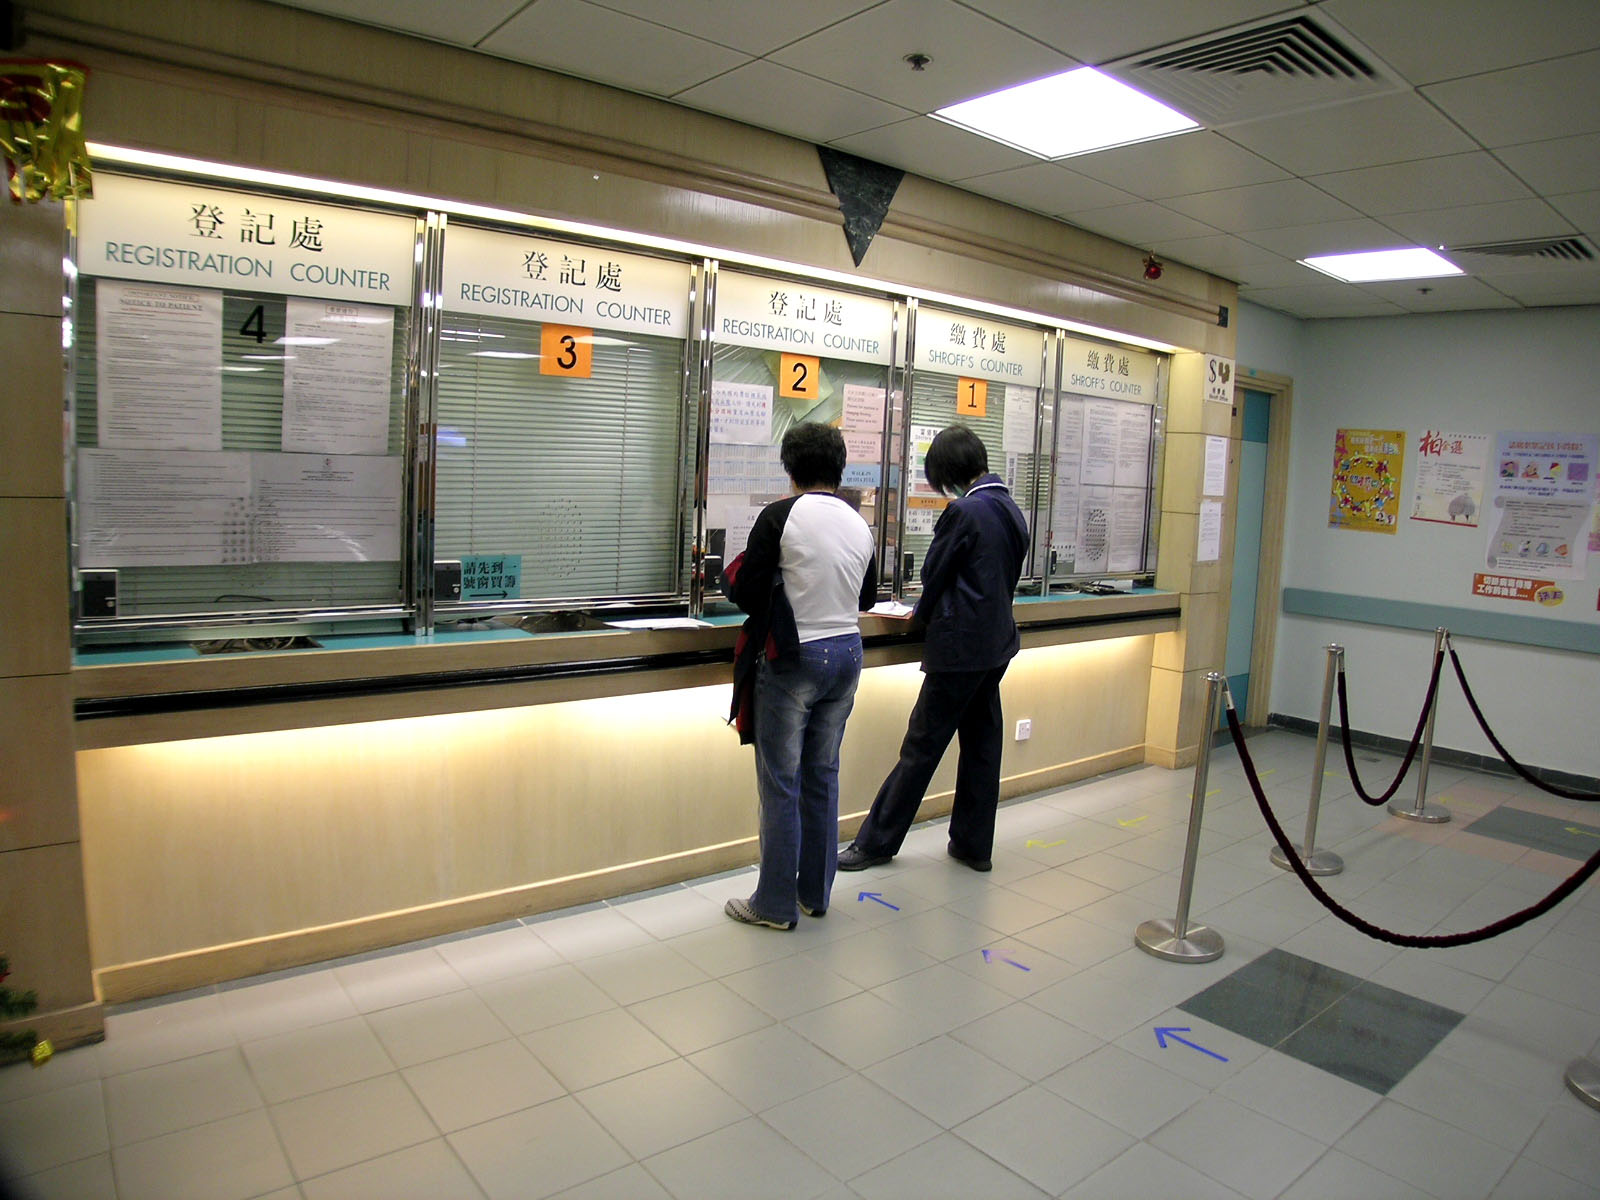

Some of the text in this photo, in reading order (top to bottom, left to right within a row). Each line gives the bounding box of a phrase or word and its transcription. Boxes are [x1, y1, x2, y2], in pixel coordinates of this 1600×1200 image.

[188, 203, 324, 252] 登記處
[105, 241, 391, 291] REGISTRATION COUNTER
[521, 250, 622, 292] 登記處
[460, 282, 671, 326] REGISTRATION COUNTER
[768, 290, 842, 326] 登記處
[239, 304, 267, 344] 4
[723, 318, 880, 355] REGISTRATION COUNTER
[949, 323, 1007, 354] 繳費處
[556, 334, 578, 370] 3
[929, 349, 1023, 377] SHROFF'S COUNTER
[1086, 349, 1130, 377] 繳費處
[791, 362, 808, 393] 2
[968, 382, 977, 409] 1
[1071, 374, 1142, 395] SHROFF'S COUNTER
